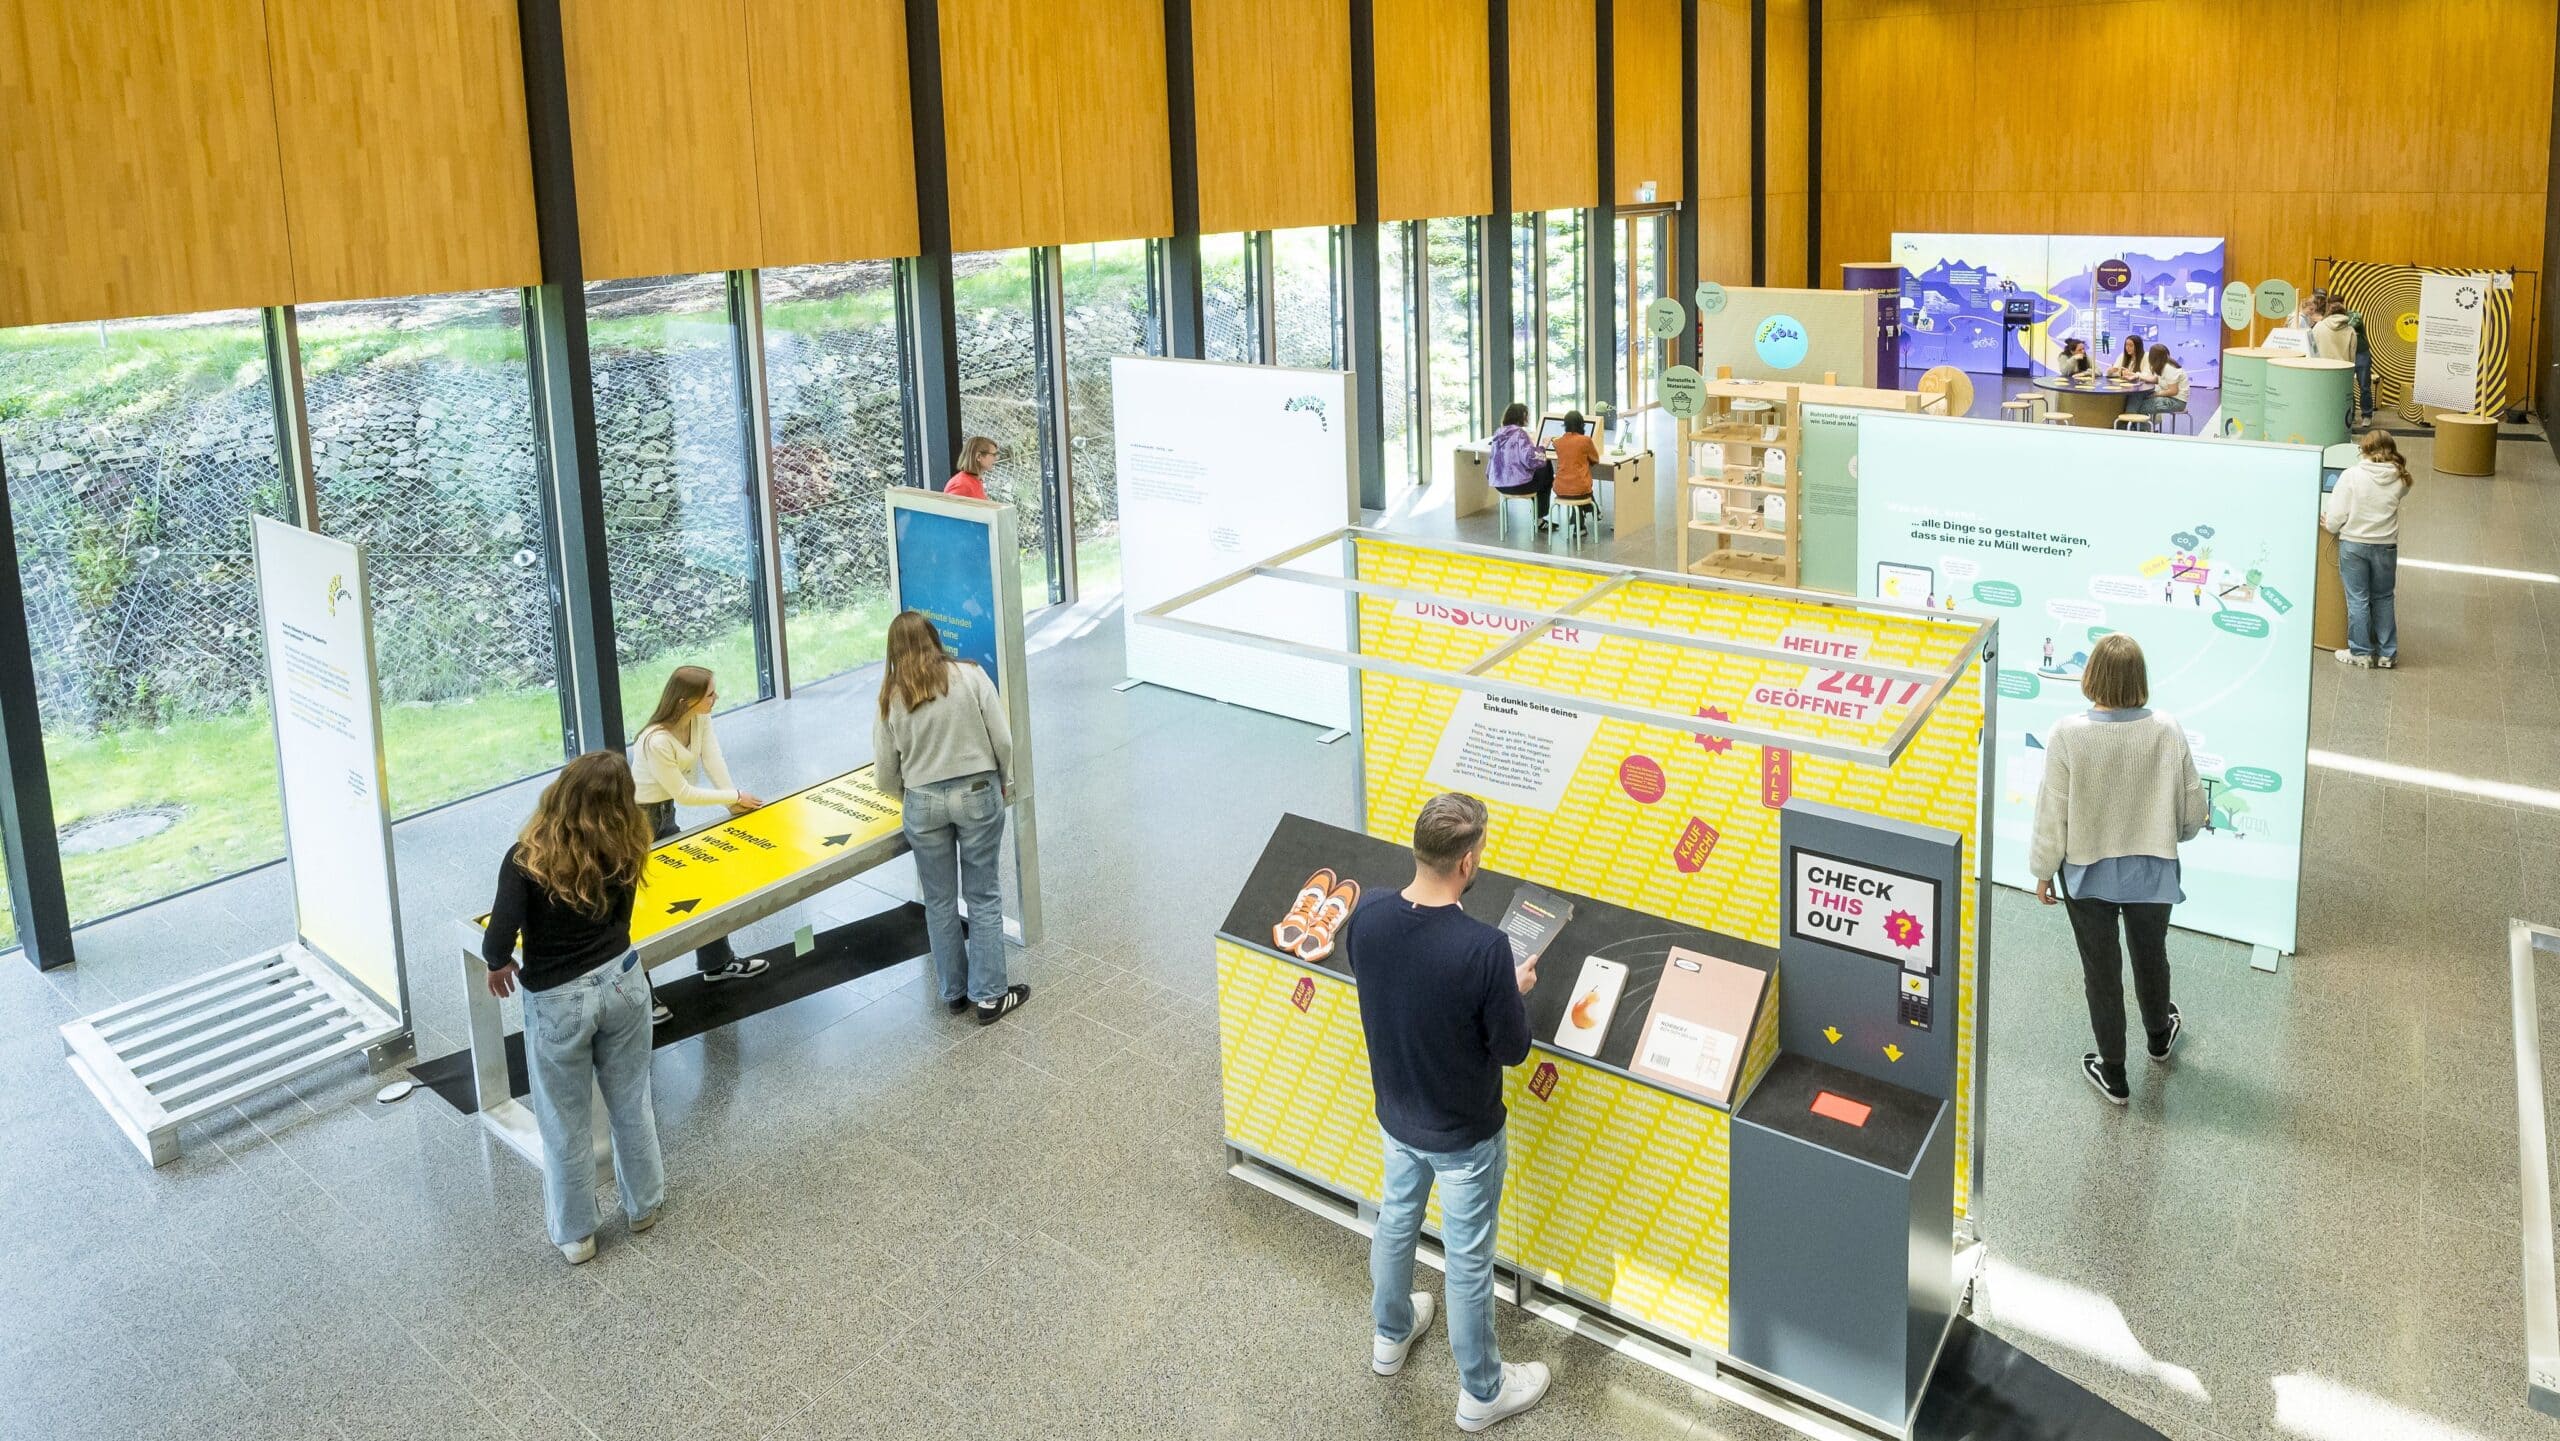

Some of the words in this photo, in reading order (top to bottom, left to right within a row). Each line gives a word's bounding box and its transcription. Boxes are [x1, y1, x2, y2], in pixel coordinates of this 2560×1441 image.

[1911, 530, 1937, 541] dass
[1939, 533, 1955, 543] sie
[1958, 535, 1975, 545] nie
[1978, 539, 1992, 547] zu
[1994, 539, 2019, 550] Müll
[2021, 544, 2073, 557] werden?
[1921, 519, 1941, 529] alle
[1943, 521, 1976, 534] Dinge
[1978, 526, 1992, 534] so
[1994, 527, 2047, 541] gestaltet
[2050, 534, 2091, 548] wären,
[1784, 636, 1858, 659] HEUTE
[1483, 703, 1518, 716] Einkaufs
[1486, 693, 1499, 703] Die
[1501, 696, 1528, 708] dunkle
[1529, 702, 1549, 712] Seite
[1550, 705, 1578, 719] deines
[1755, 688, 1868, 719] GEÖFFNET
[1771, 751, 1782, 801] SALE
[805, 793, 880, 824] Überflusses!
[822, 786, 901, 817] grenzenlosen
[701, 835, 739, 854] weiter
[723, 826, 777, 851] schneller
[1679, 825, 1701, 860] KAUF
[678, 842, 720, 865] billiger
[1690, 832, 1716, 868] MICH!
[654, 853, 688, 870] mehr
[1807, 866, 1894, 901] CHECK
[1808, 888, 1864, 916] THIS
[1807, 910, 1859, 936] OUT
[1896, 918, 1912, 939] ?
[1532, 1067, 1546, 1090] KAUF
[1540, 1072, 1556, 1098] MICH!
[1620, 1096, 1661, 1114] kaufen
[1625, 1086, 1666, 1104] kaufen
[1564, 1100, 1602, 1118] kaufen
[1614, 1106, 1654, 1124] kaufen
[1672, 1102, 1714, 1120] kaufen
[1553, 1120, 1591, 1139] kaufen
[1608, 1116, 1648, 1135] kaufen
[1665, 1111, 1707, 1131] kaufen
[1547, 1130, 1584, 1149] kaufen
[1602, 1127, 1642, 1145] kaufen
[1653, 1132, 1694, 1152] kaufen
[1659, 1122, 1701, 1142] kaufen
[1542, 1140, 1579, 1158] kaufen
[1590, 1146, 1629, 1165] kaufen
[1596, 1136, 1636, 1155] kaufen
[1646, 1142, 1687, 1162] kaufen
[1531, 1160, 1568, 1178] kaufen
[1537, 1150, 1574, 1168] kaufen
[1584, 1157, 1623, 1175] kaufen
[1640, 1152, 1682, 1172] kaufen
[1578, 1166, 1617, 1185] kaufen
[1635, 1162, 1675, 1182] kaufen
[1519, 1178, 1556, 1197] kaufen
[1628, 1173, 1668, 1192] kaufen
[1680, 1180, 1721, 1200] kaufen
